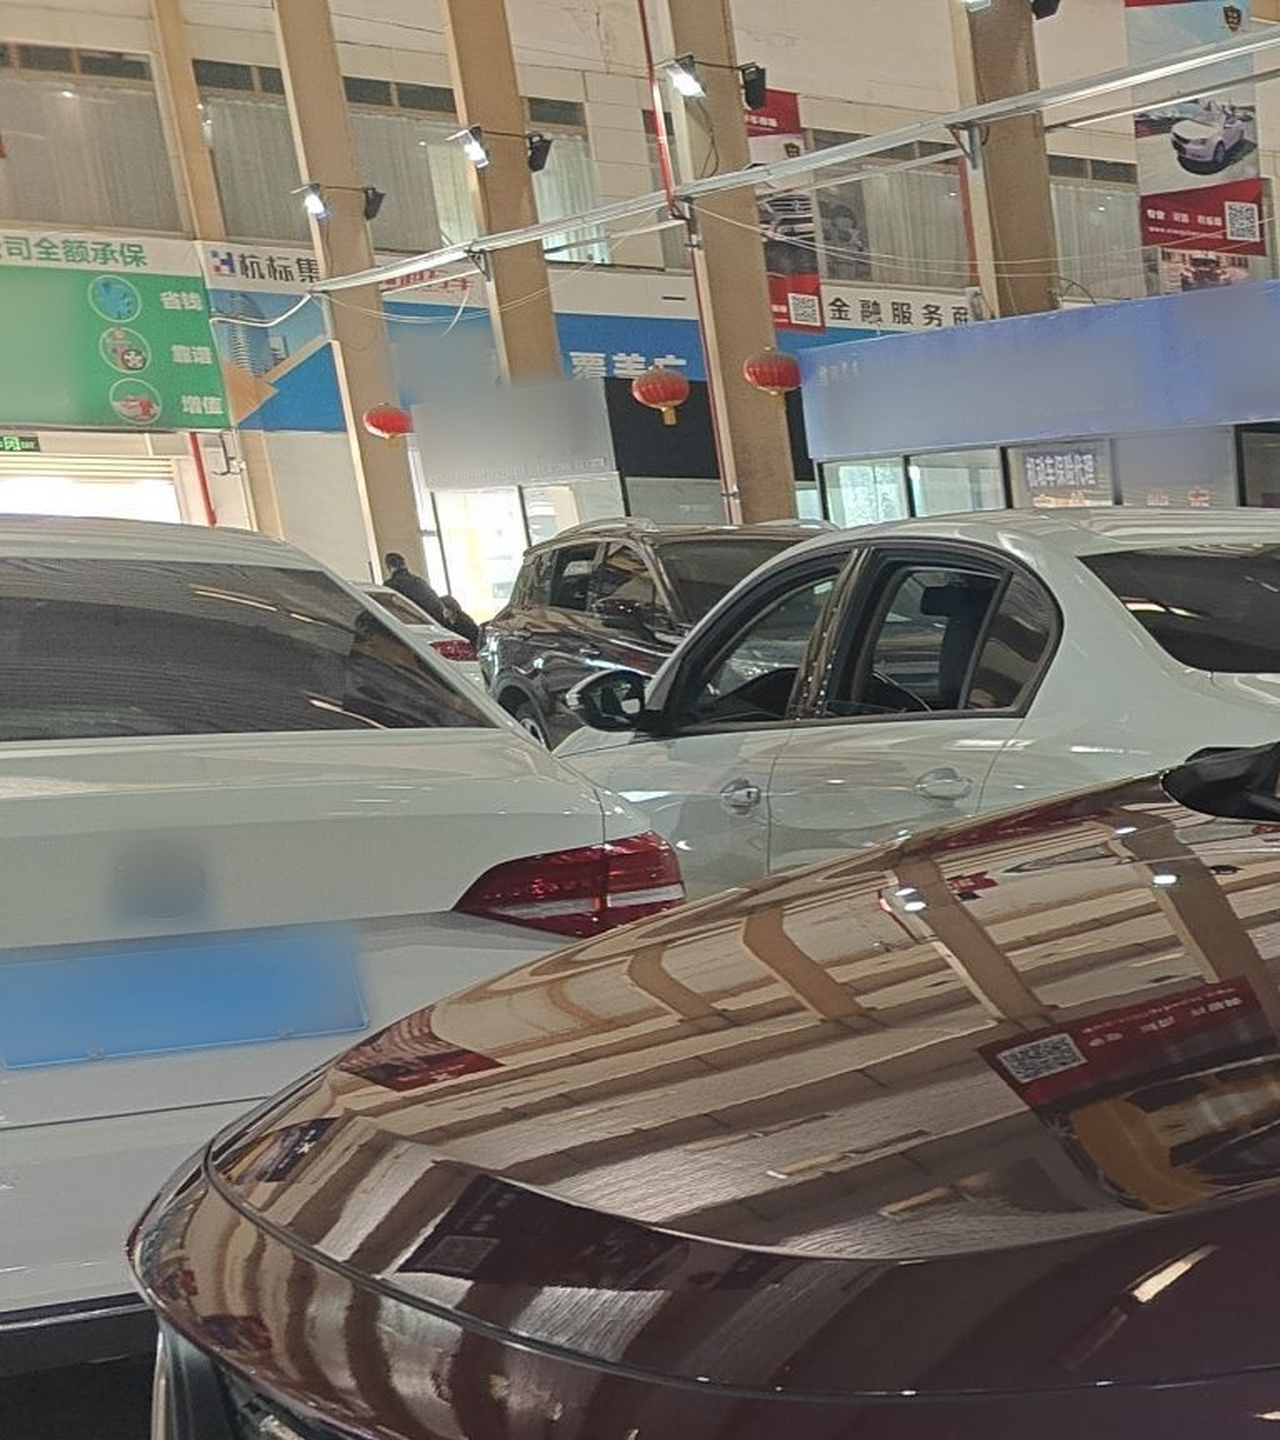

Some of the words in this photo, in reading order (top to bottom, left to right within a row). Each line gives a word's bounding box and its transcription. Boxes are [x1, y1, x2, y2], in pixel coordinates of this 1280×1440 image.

[0, 235, 147, 267] 司全额承保
